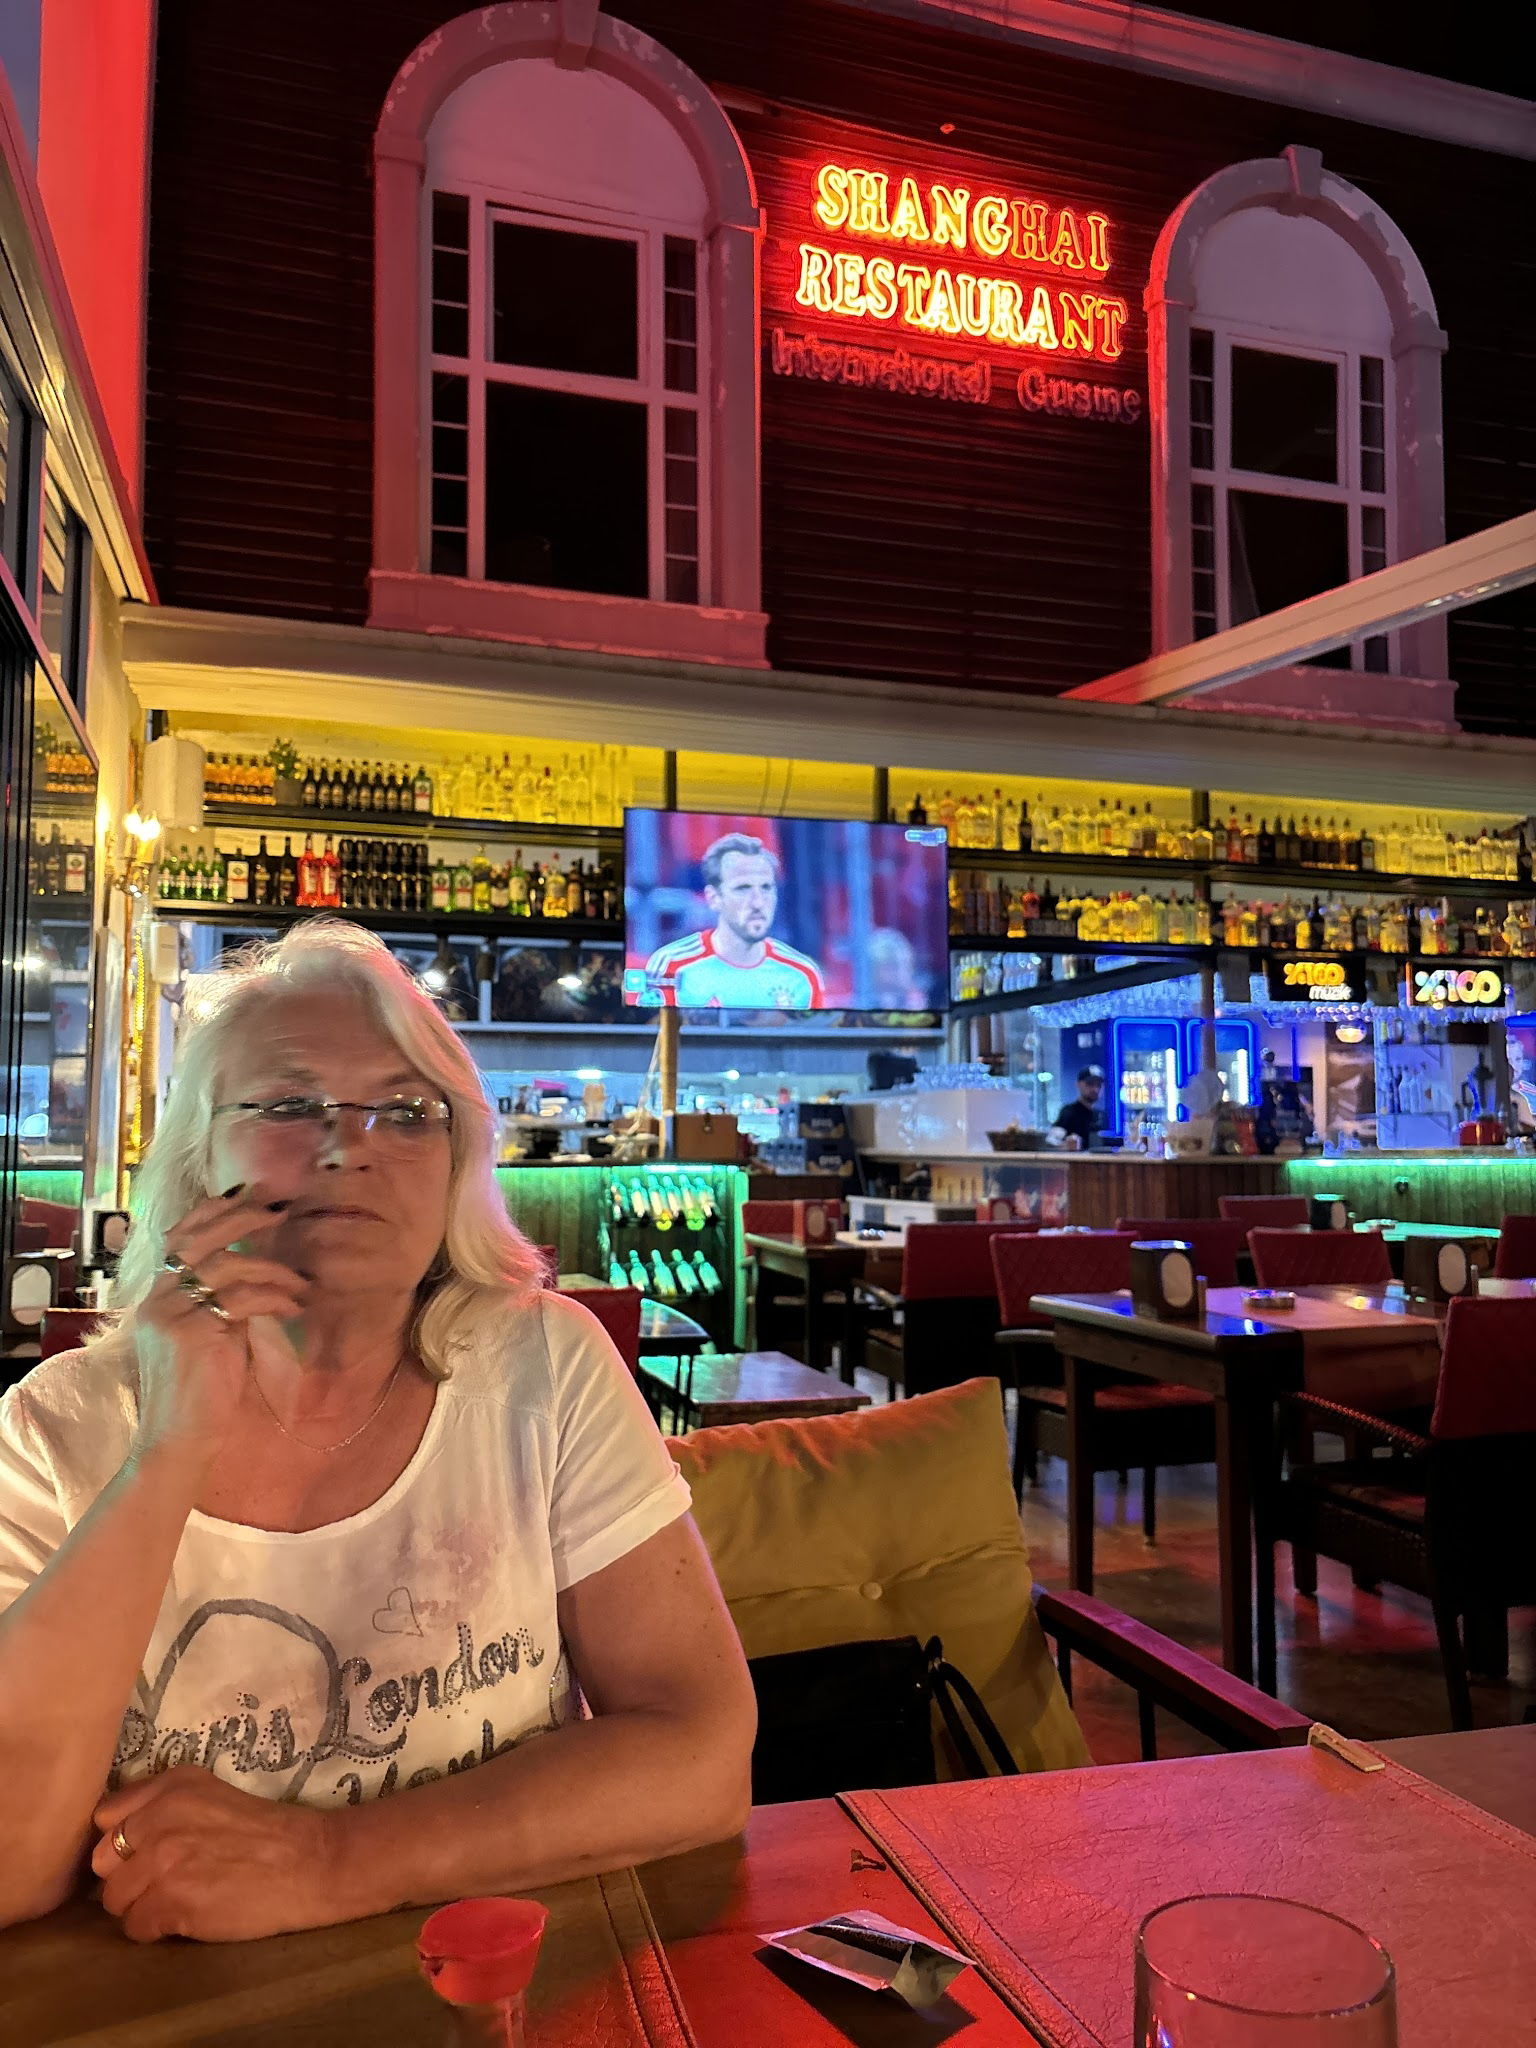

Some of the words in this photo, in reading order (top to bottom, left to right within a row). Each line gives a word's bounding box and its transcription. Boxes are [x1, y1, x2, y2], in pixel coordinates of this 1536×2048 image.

[815, 165, 1111, 271] SHANGHAI
[796, 244, 1128, 357] RESTAURANT
[772, 327, 992, 404] International
[1414, 970, 1502, 1003] %100
[310, 1621, 545, 1764] London
